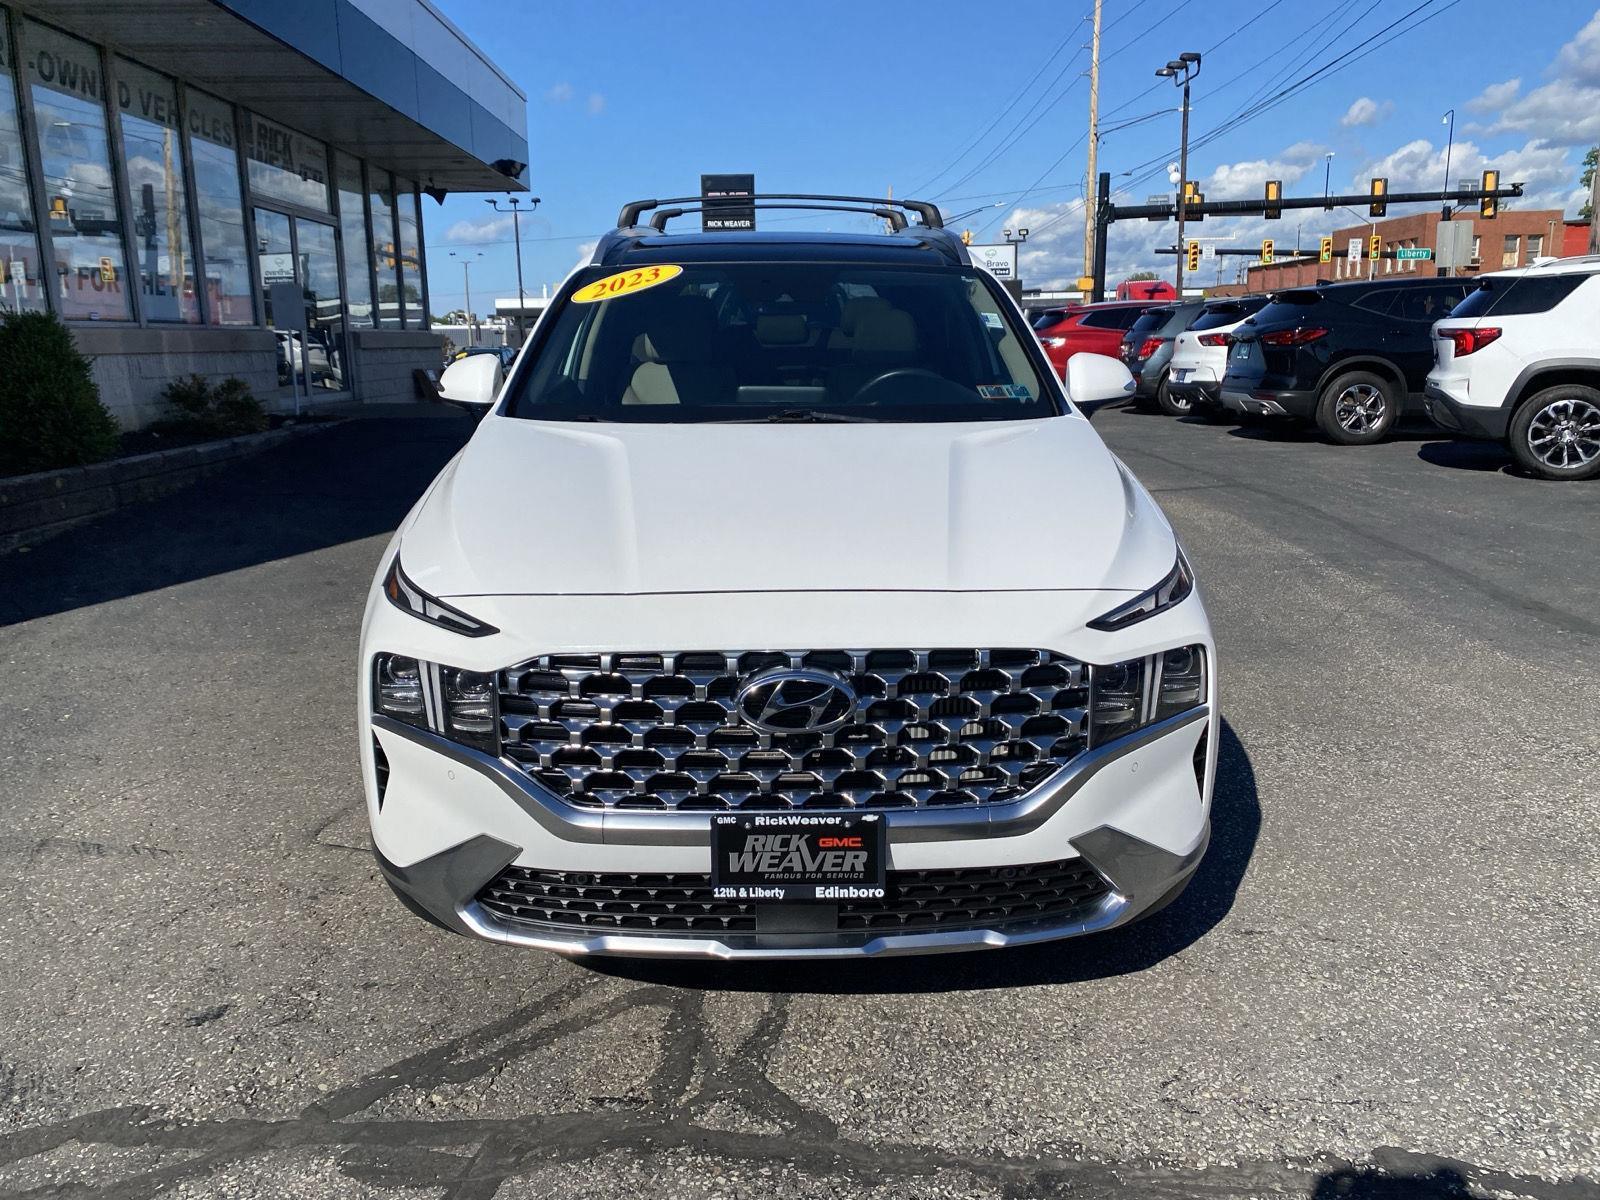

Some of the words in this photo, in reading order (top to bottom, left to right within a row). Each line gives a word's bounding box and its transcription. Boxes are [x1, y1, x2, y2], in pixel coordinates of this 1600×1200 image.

[138, 88, 233, 146] VEHCLES
[1400, 249, 1427, 259] Liberty
[592, 268, 661, 299] 2023
[717, 816, 737, 824] GMC
[755, 816, 842, 826] RickWeaver
[744, 834, 811, 852] RICK
[818, 837, 863, 848] GMC
[729, 850, 868, 873] WEAVER
[713, 887, 737, 898] 12th
[738, 887, 748, 898] &
[749, 887, 785, 900] Liberty
[815, 886, 885, 899] Edinboro
